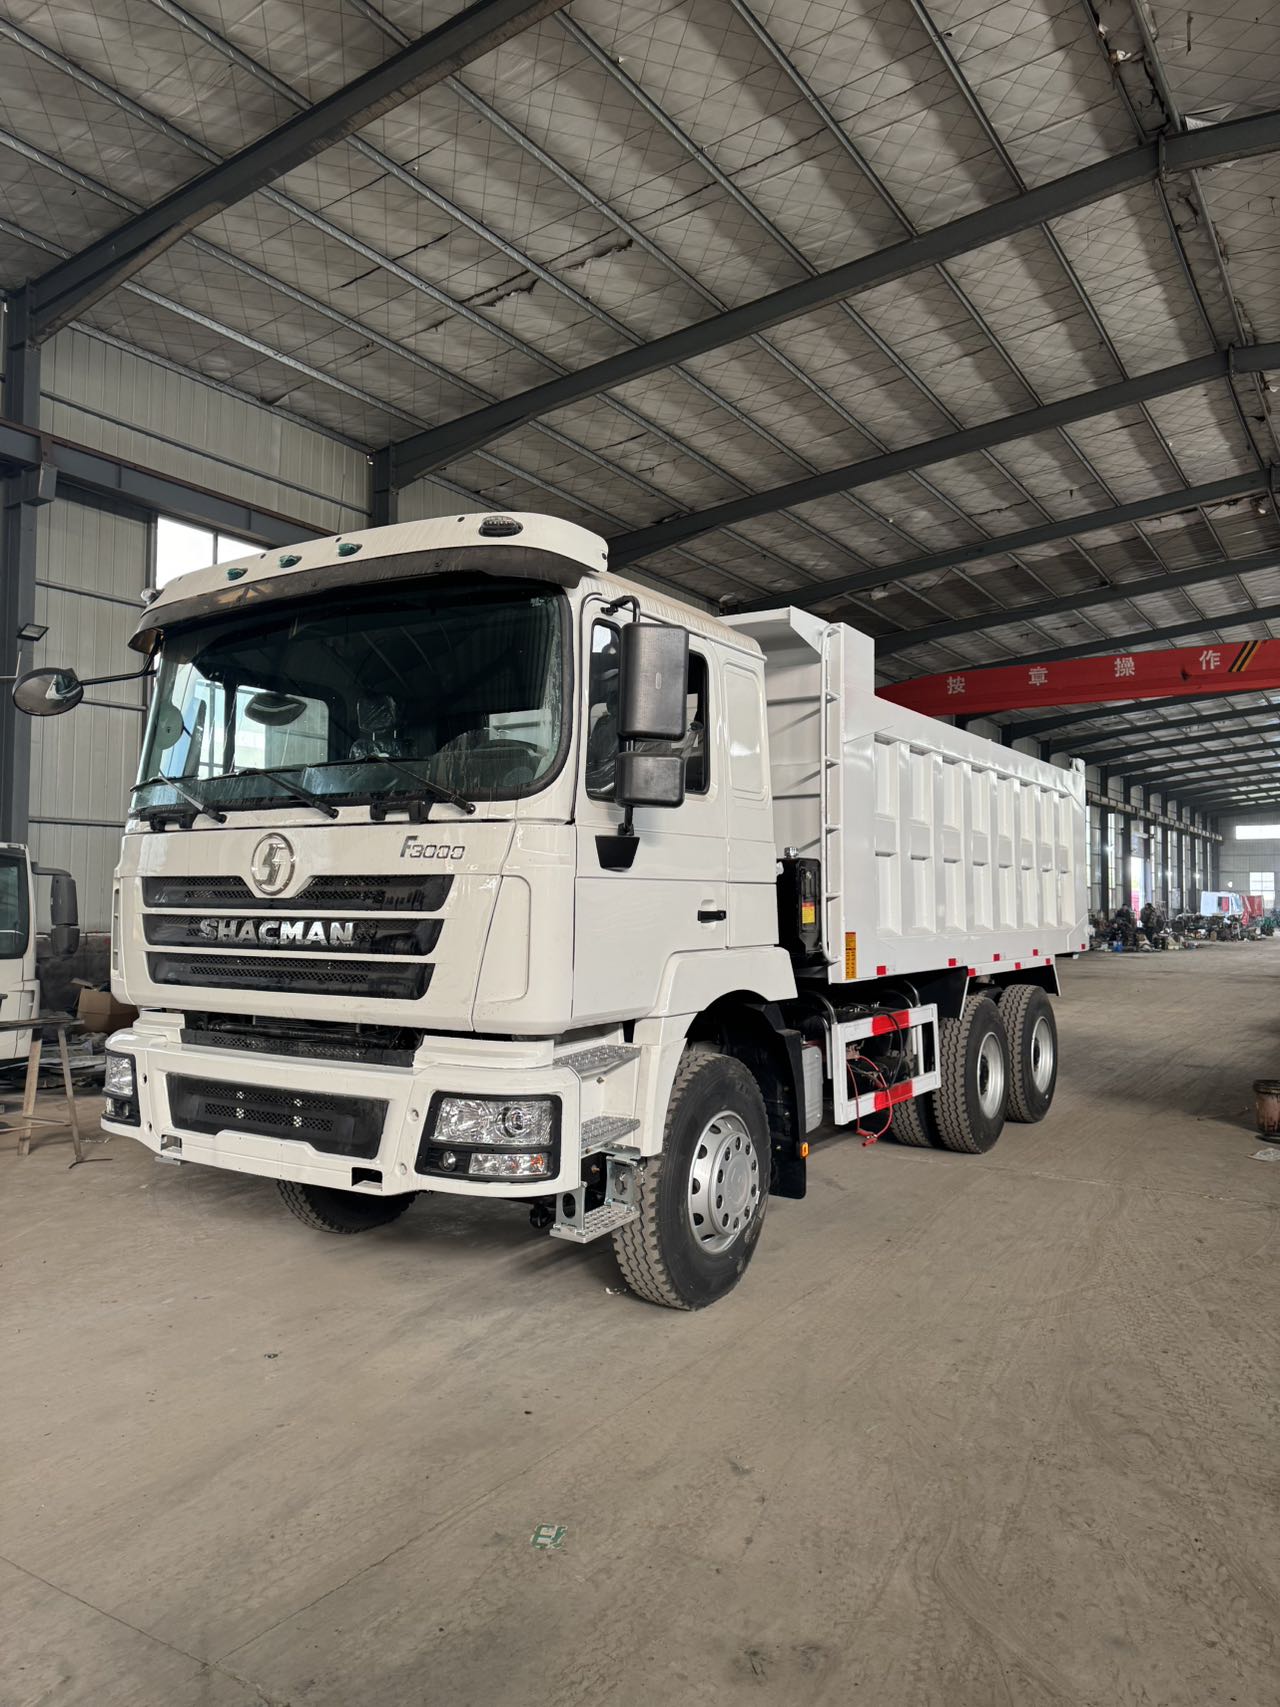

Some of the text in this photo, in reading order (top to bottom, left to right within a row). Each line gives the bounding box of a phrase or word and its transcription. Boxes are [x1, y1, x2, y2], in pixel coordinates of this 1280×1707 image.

[947, 650, 1221, 694] 按章操作
[400, 835, 466, 860] F3000
[200, 918, 354, 946] SHACMAN
